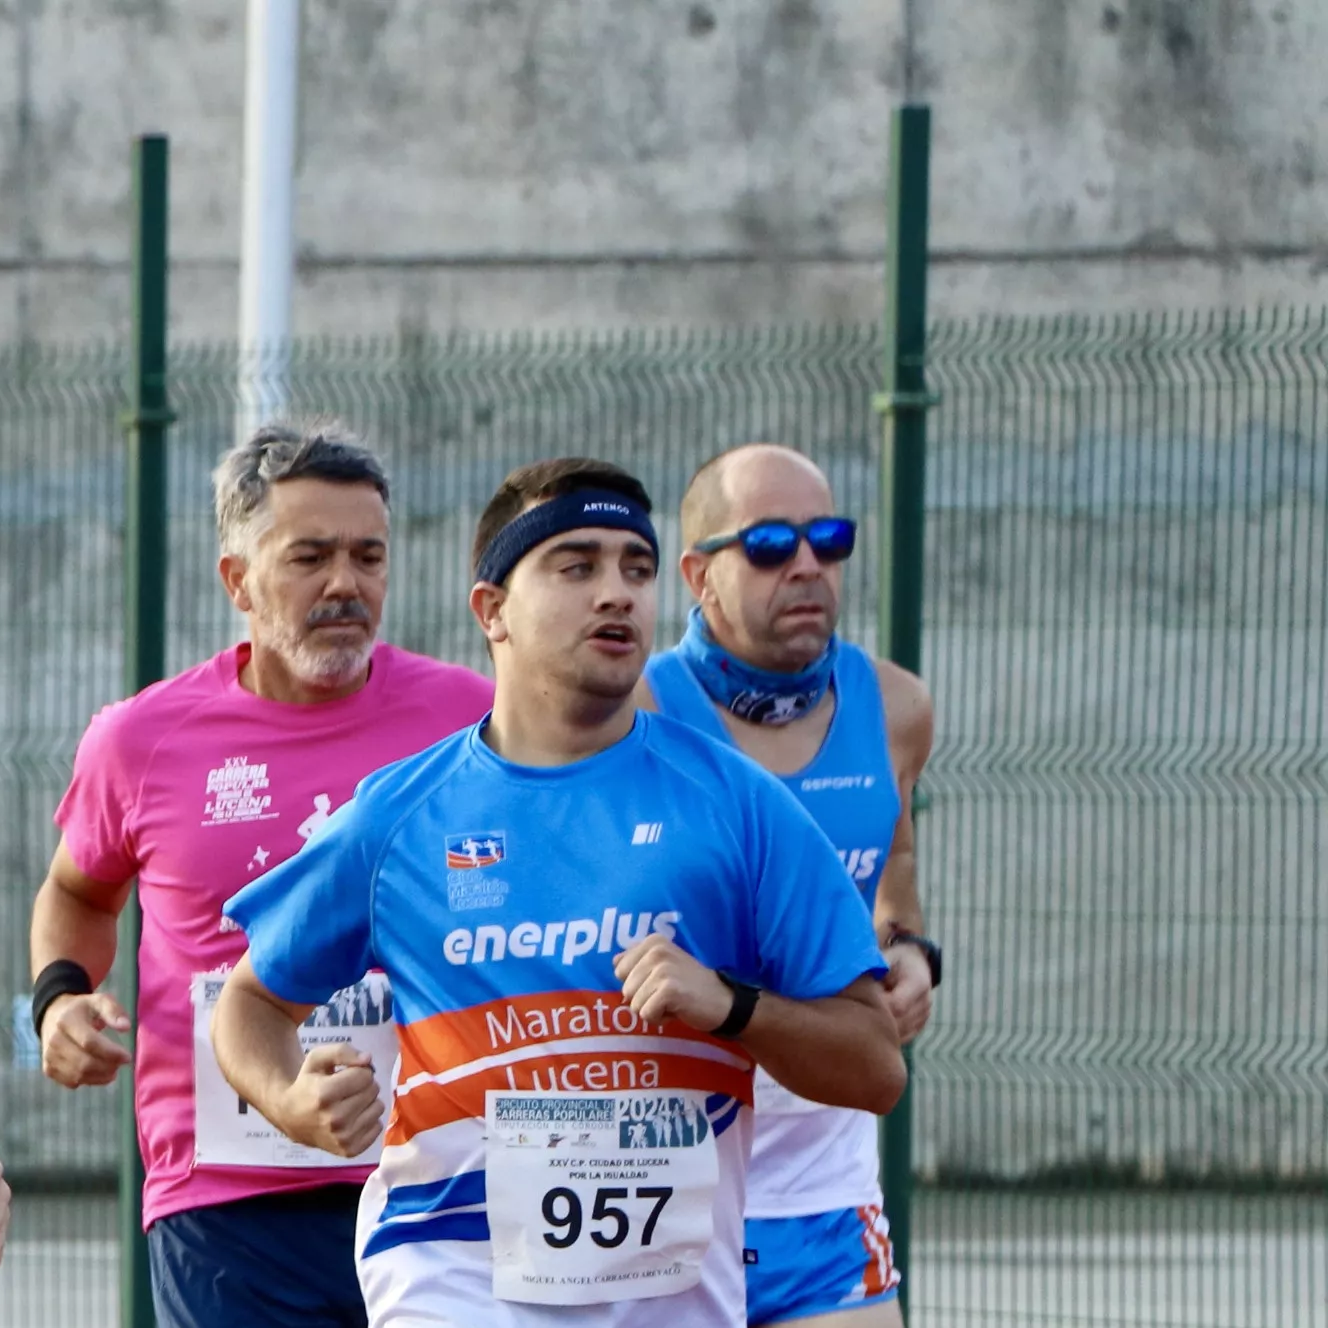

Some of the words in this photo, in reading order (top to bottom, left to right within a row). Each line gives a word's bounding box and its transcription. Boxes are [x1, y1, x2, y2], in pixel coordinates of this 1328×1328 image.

[583, 502, 630, 515] ARTENGO
[443, 907, 682, 966] enerplus
[505, 1059, 660, 1092] Lucena
[496, 1100, 539, 1110] CIRCUITO
[543, 1100, 599, 1110] PROVINCIAL
[619, 1098, 672, 1122] 2024
[496, 1110, 550, 1121] CARRERAS
[553, 1109, 614, 1121] POPULARES
[549, 1158, 569, 1167] XXV
[589, 1158, 622, 1167] CIUDAD
[624, 1158, 635, 1167] DE
[637, 1158, 670, 1167] LUCENA
[569, 1171, 587, 1180] POR
[589, 1171, 601, 1180] LA
[603, 1171, 649, 1180] IGUALDAD
[541, 1186, 674, 1249] 957
[594, 1271, 639, 1284] CARRASCO
